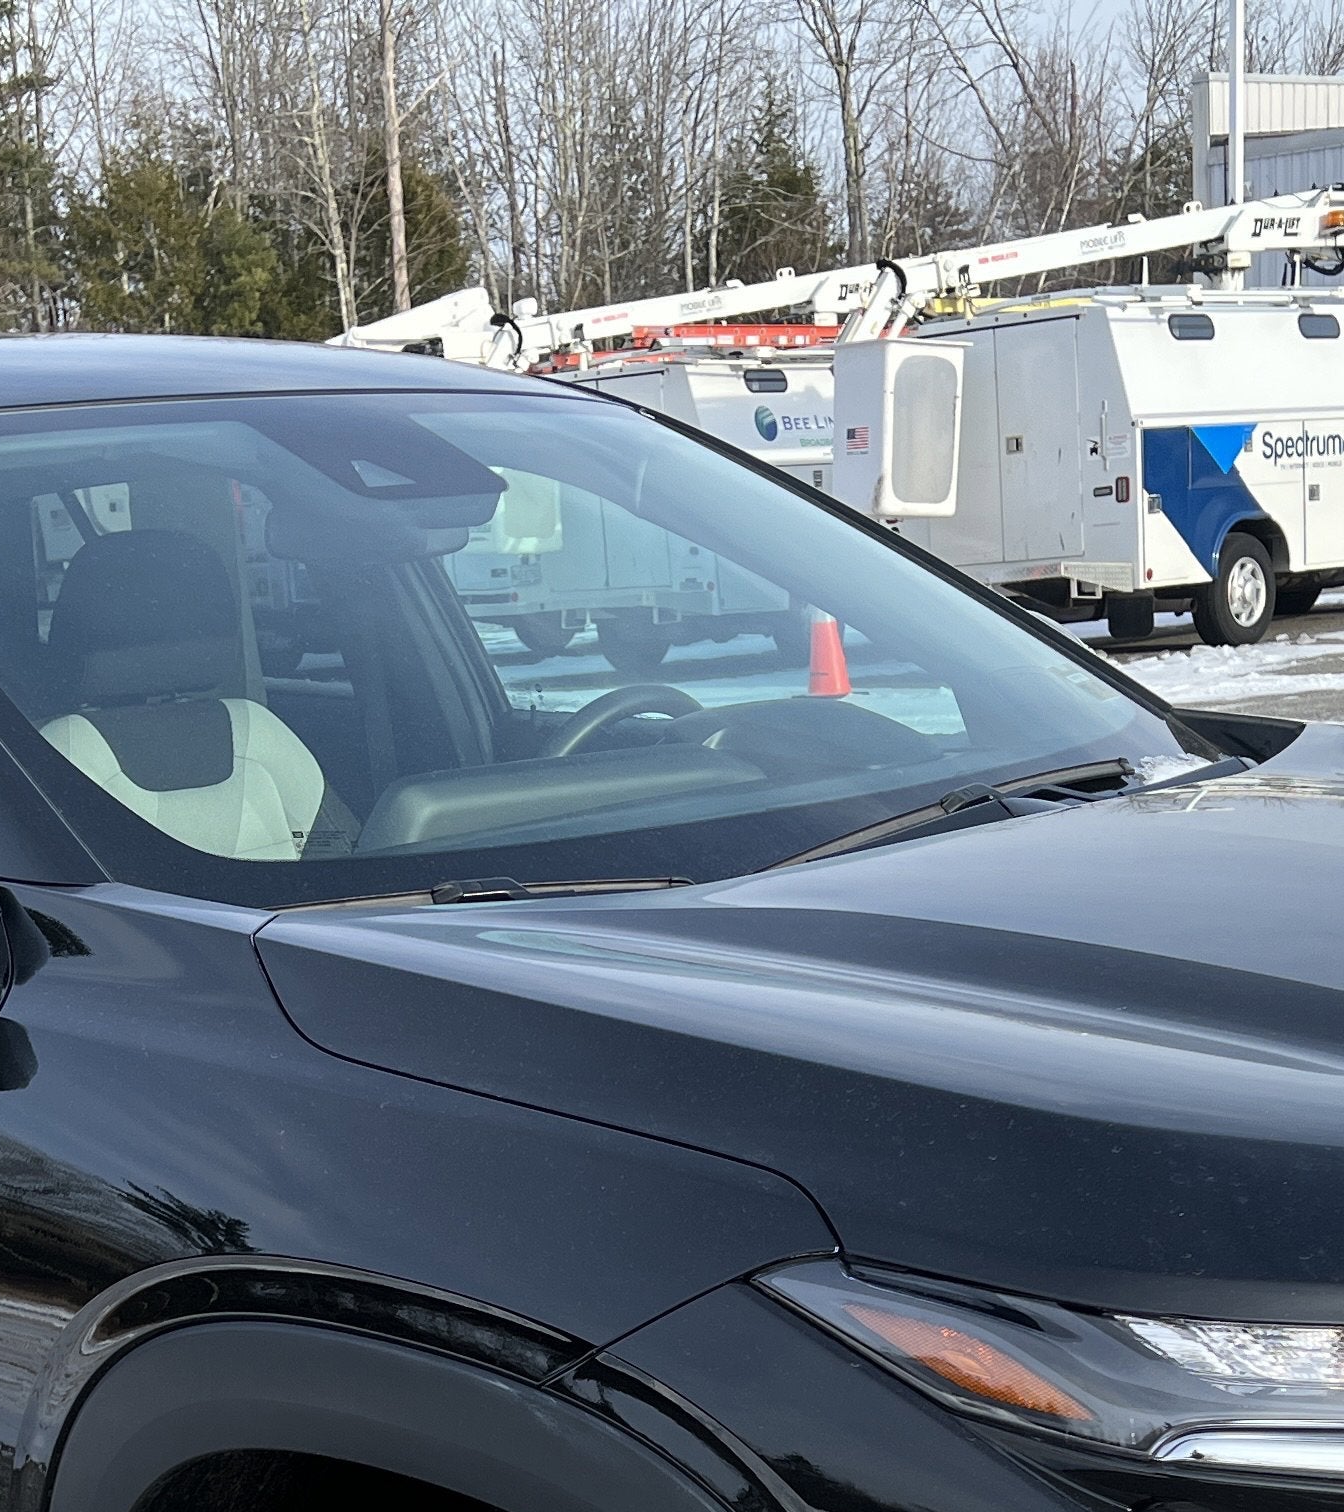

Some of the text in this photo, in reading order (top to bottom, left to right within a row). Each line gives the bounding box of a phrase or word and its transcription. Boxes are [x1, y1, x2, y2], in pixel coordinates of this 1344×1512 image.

[1251, 217, 1301, 236] DUR-A-LIFT
[781, 415, 812, 431] BEE
[1262, 429, 1343, 467] Spectrum
